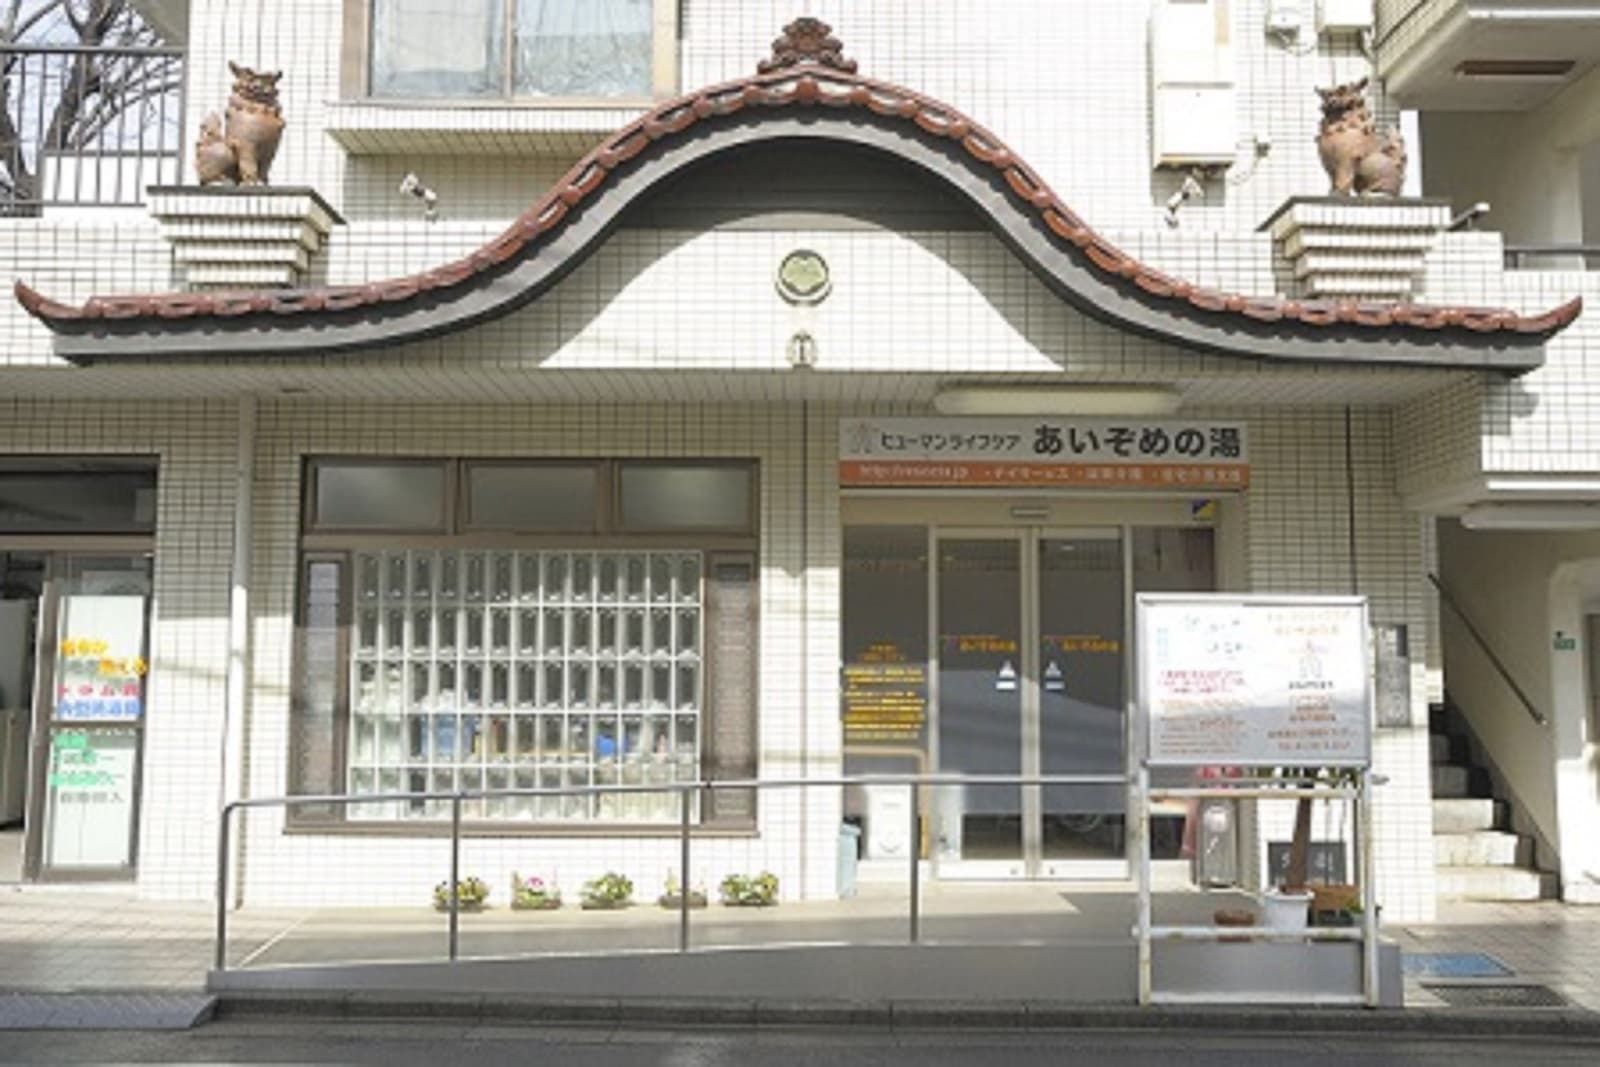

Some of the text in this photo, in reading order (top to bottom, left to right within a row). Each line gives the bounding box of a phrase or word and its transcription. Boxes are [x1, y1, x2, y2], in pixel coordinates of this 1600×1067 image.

[1033, 424, 1241, 457] あいぞめの湯
